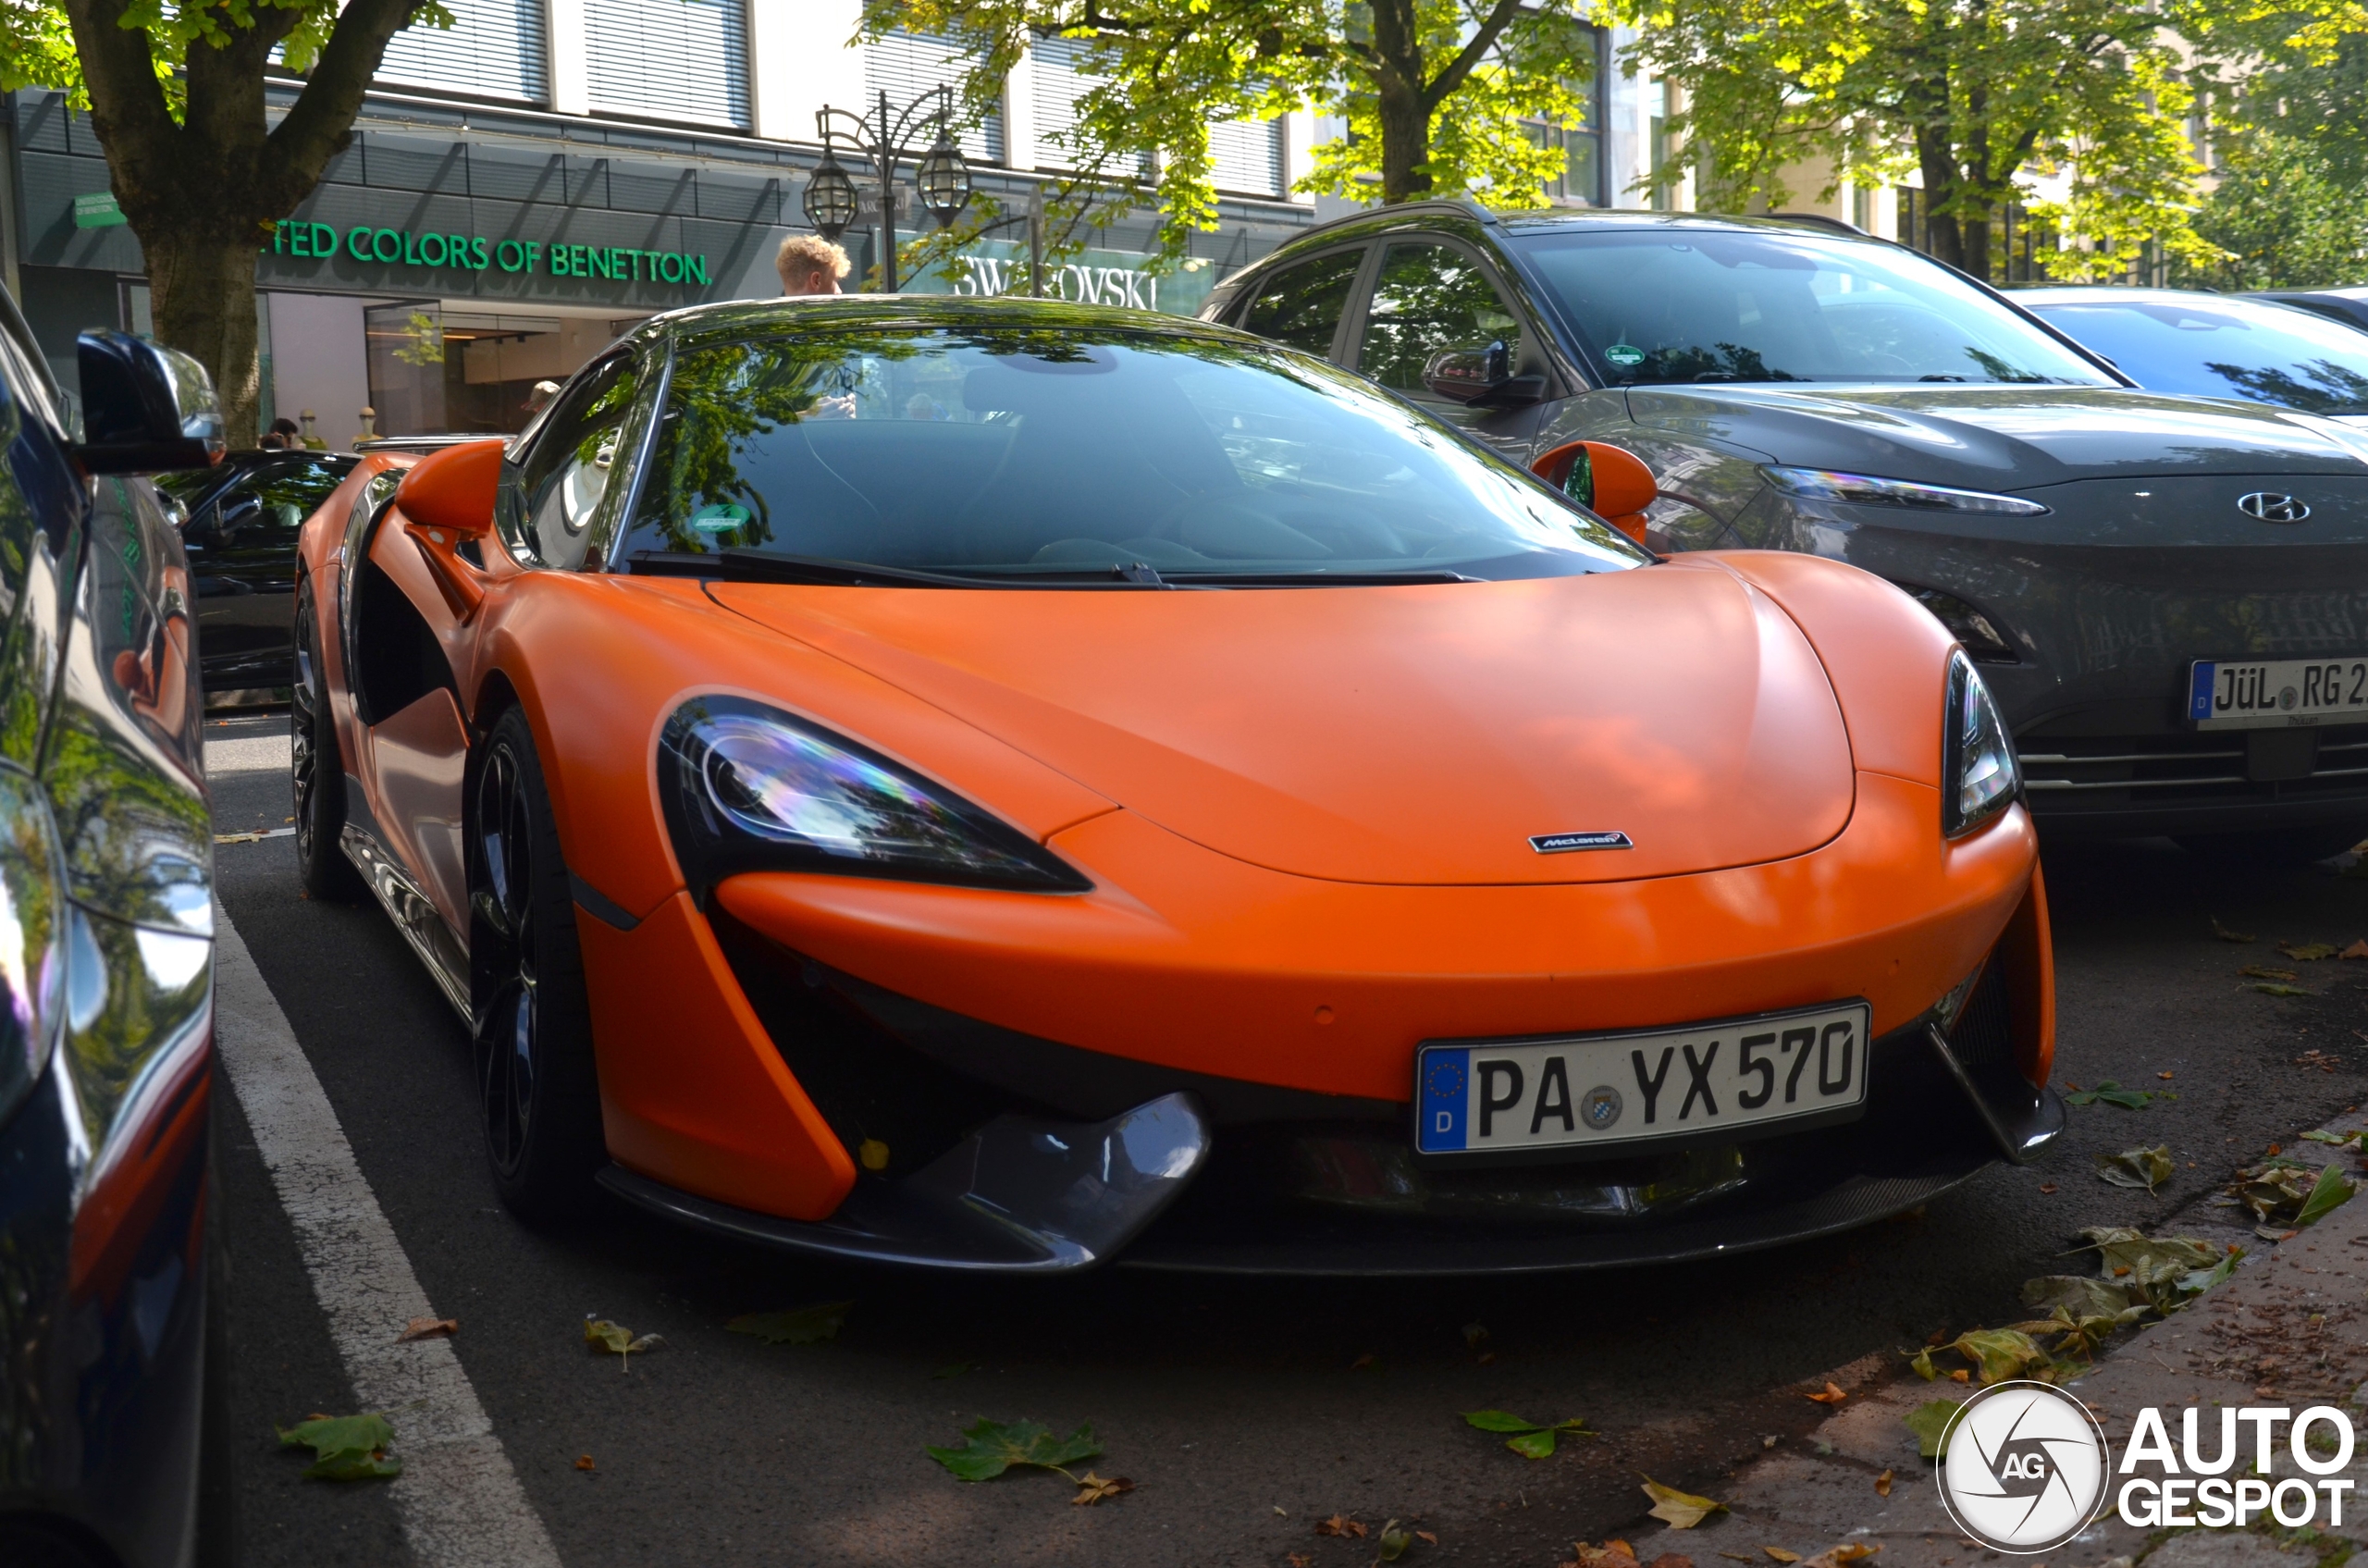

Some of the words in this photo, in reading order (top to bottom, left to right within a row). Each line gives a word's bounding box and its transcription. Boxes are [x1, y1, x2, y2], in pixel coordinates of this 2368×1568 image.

[274, 220, 339, 258] TED
[347, 227, 490, 271] COLORS
[497, 240, 541, 274] OF
[549, 243, 713, 286] BENETTON.
[2197, 696, 2207, 710] D
[2214, 667, 2276, 711] JÜL
[2302, 663, 2343, 708] RG
[2348, 662, 2368, 705] 2
[1542, 835, 1618, 847] McLaren
[1476, 1056, 1575, 1138] PA
[1631, 1040, 1720, 1124] YX
[1737, 1020, 1855, 1110] 570
[1436, 1111, 1452, 1133] D
